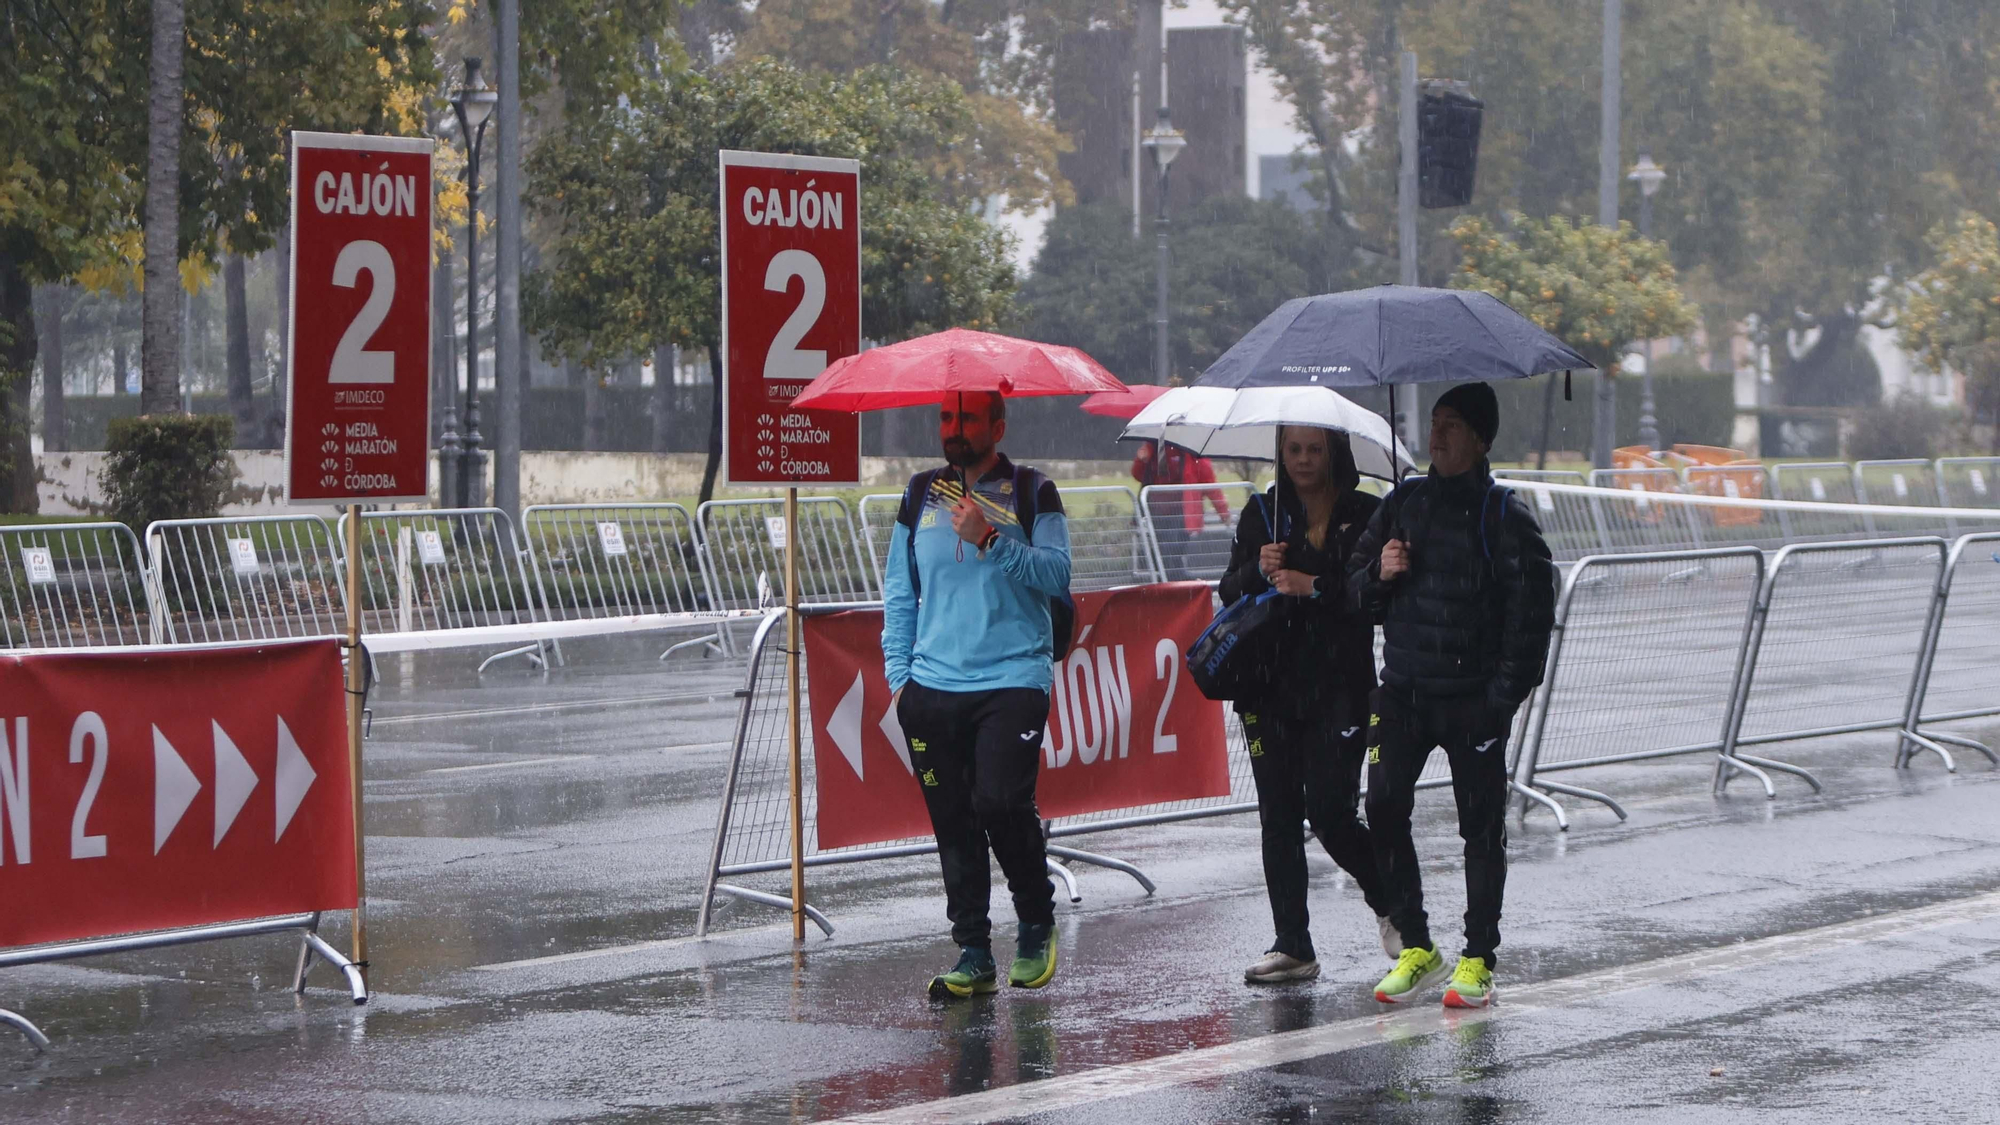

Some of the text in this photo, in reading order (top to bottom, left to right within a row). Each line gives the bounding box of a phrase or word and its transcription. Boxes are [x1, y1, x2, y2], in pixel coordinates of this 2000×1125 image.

[315, 161, 416, 217] CAJÓN
[743, 178, 843, 230] CAJÓN
[328, 240, 396, 384] 2
[763, 249, 828, 379] 2
[1281, 365, 1321, 374] PROFILTER
[346, 390, 385, 403] IMDECO
[345, 422, 379, 438] MEDIA
[780, 414, 812, 428] MEDIA
[780, 427, 831, 444] MARATÓN
[345, 436, 397, 455] MARATÓN
[780, 458, 831, 475] CÓRDOBA
[344, 471, 397, 490] CÓRDOBA
[1153, 638, 1180, 754] 2
[69, 710, 109, 860] 2
